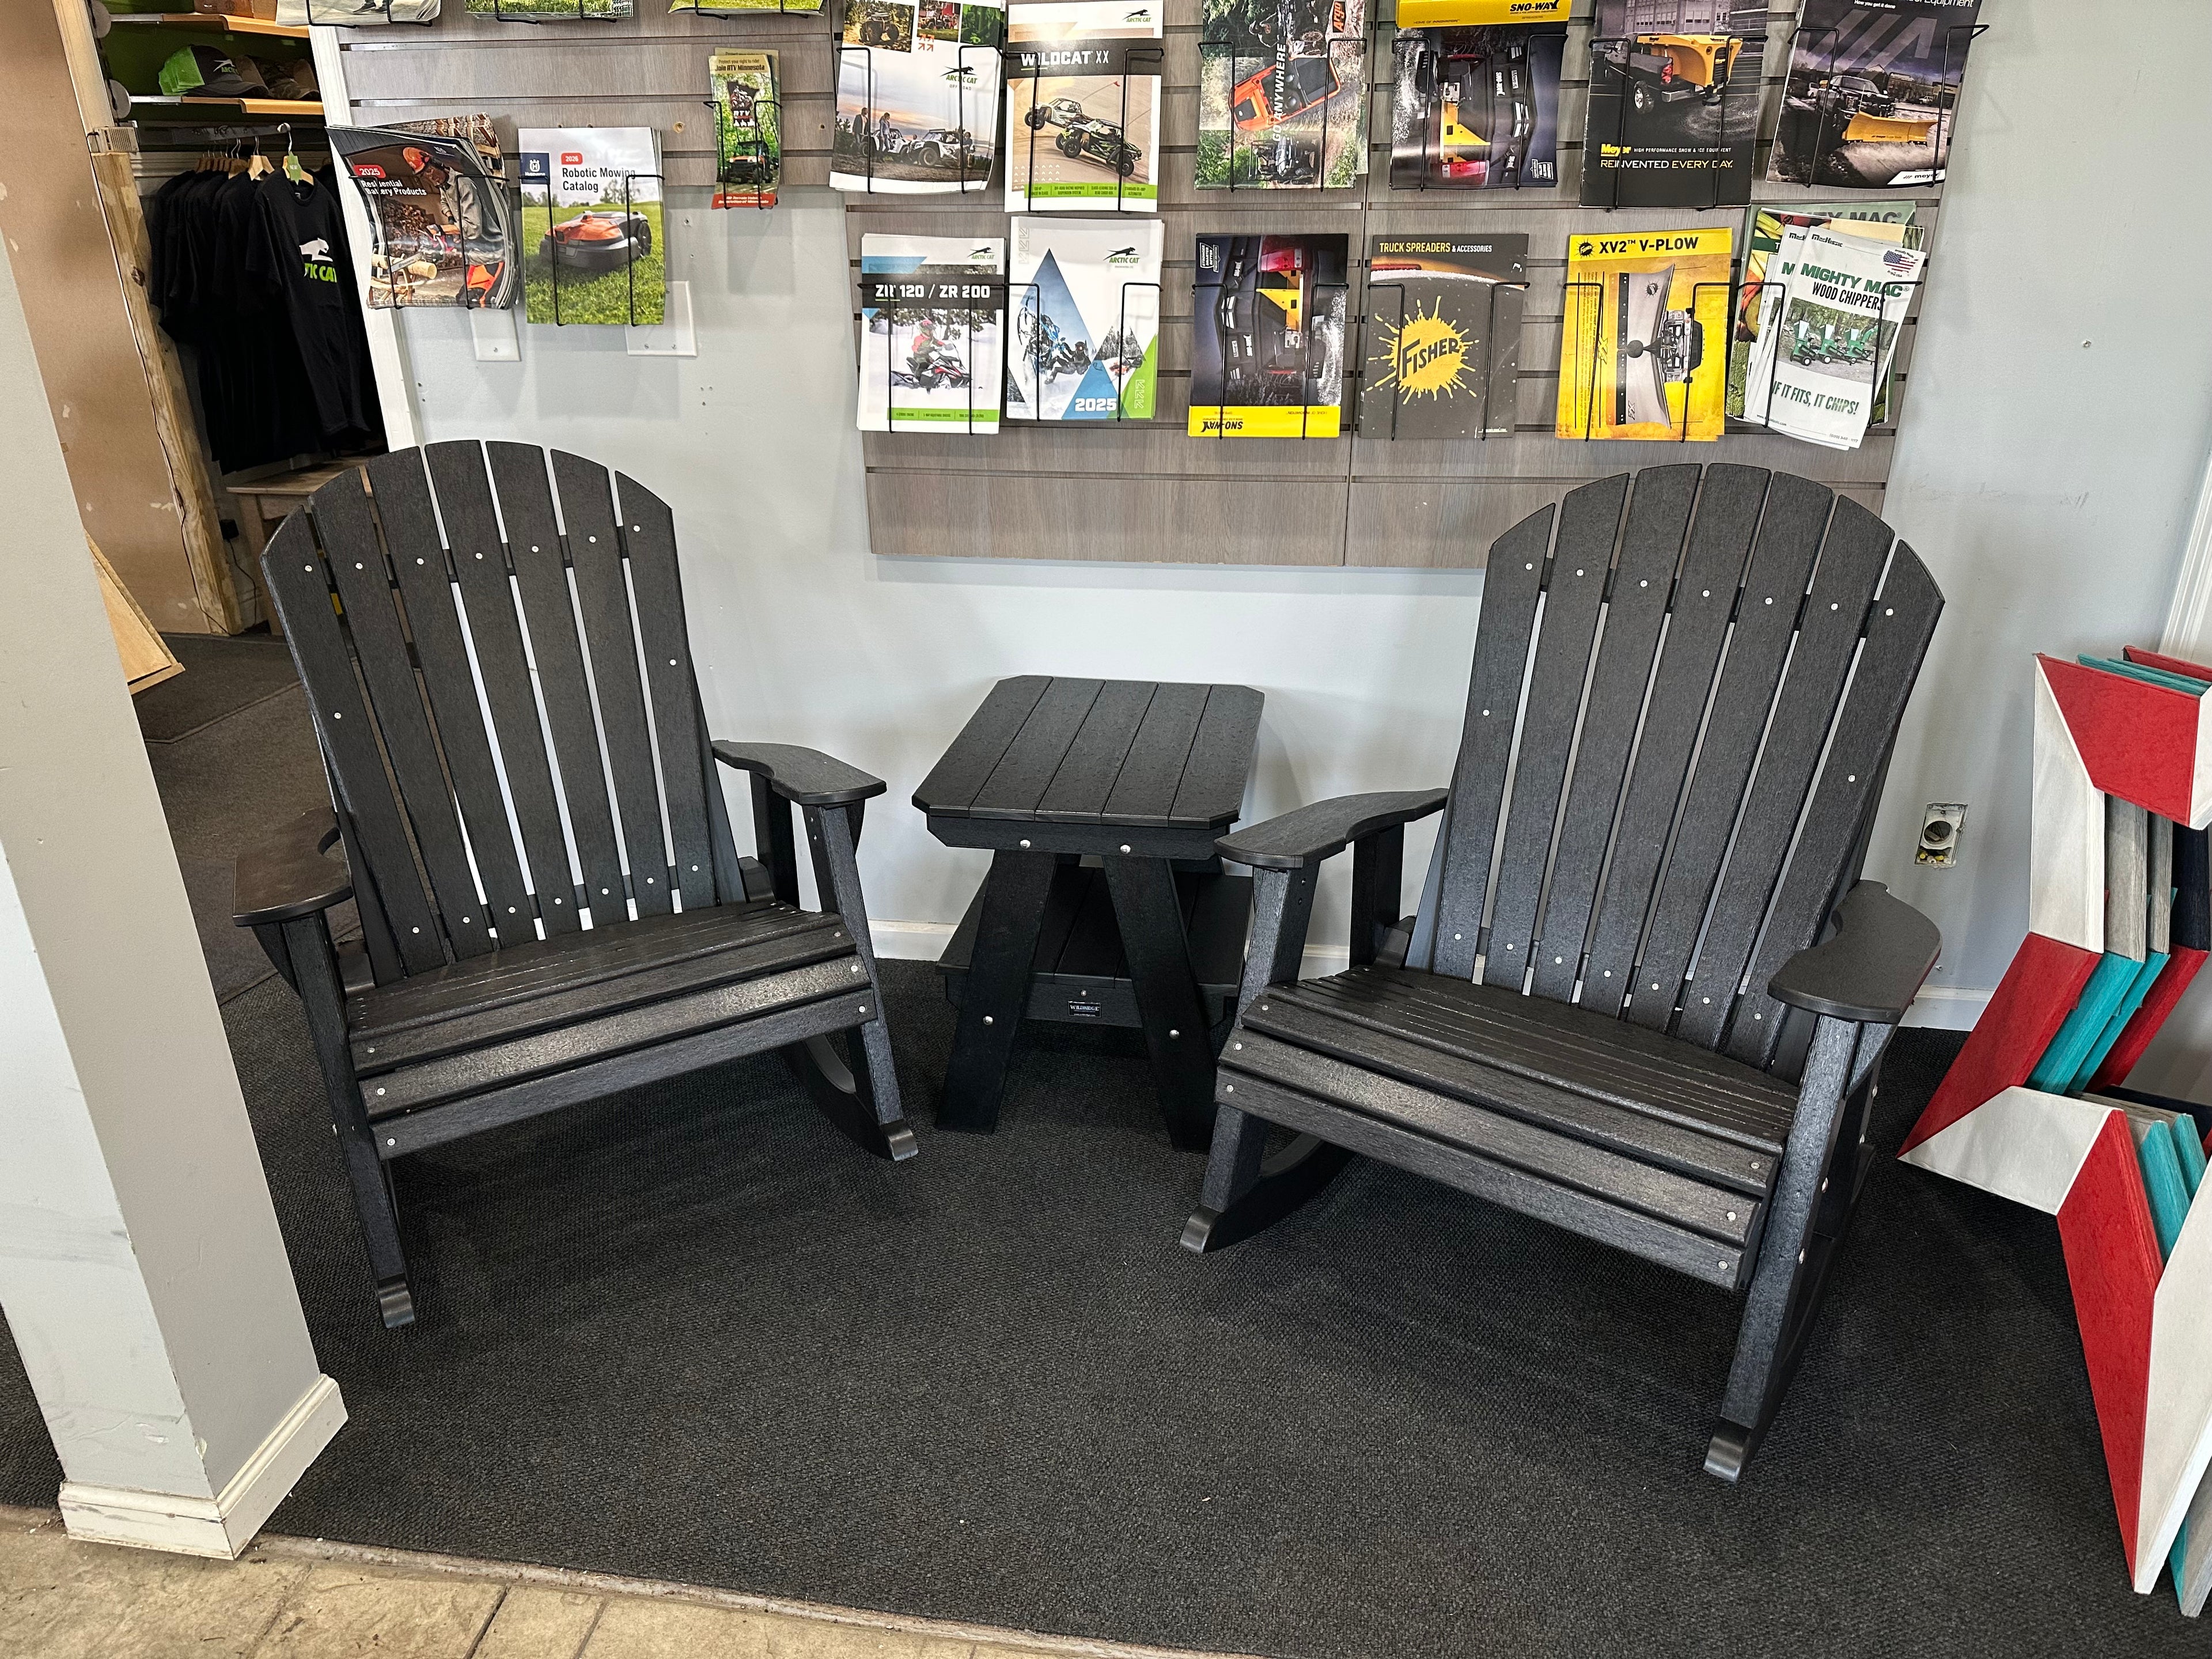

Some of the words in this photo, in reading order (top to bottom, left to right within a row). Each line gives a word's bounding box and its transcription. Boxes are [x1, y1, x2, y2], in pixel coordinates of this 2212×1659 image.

[1510, 0, 1559, 12] SNO-WAY
[1021, 51, 1091, 66] WILDCAT
[1096, 50, 1109, 64] XX
[1274, 43, 1286, 122] ANYWHERE
[1272, 124, 1282, 142] GO
[1672, 160, 1709, 169] EVERY
[562, 168, 597, 177] Robotic
[600, 168, 635, 179] Mowing
[365, 188, 392, 196] Batery
[395, 188, 427, 196] Products
[563, 180, 599, 192] Catalog
[1380, 243, 1404, 252] TRUCK
[1406, 243, 1450, 252] SPREADERS
[1639, 237, 1699, 252] V-PLOW
[1800, 263, 1863, 289] MIGHTY
[899, 285, 924, 297] 120
[928, 284, 935, 298] /
[940, 285, 957, 298] ZR
[962, 285, 990, 298] 200
[1812, 282, 1838, 300] WOOD
[1839, 289, 1886, 310] CHIPPERS
[1402, 338, 1460, 380] FISHER
[1075, 398, 1117, 411] 2025
[1771, 381, 1782, 395] IF
[1781, 384, 1792, 398] IT
[1790, 387, 1812, 407] FITS,
[1813, 393, 1825, 408] IT
[1825, 396, 1859, 415] CHIPS!
